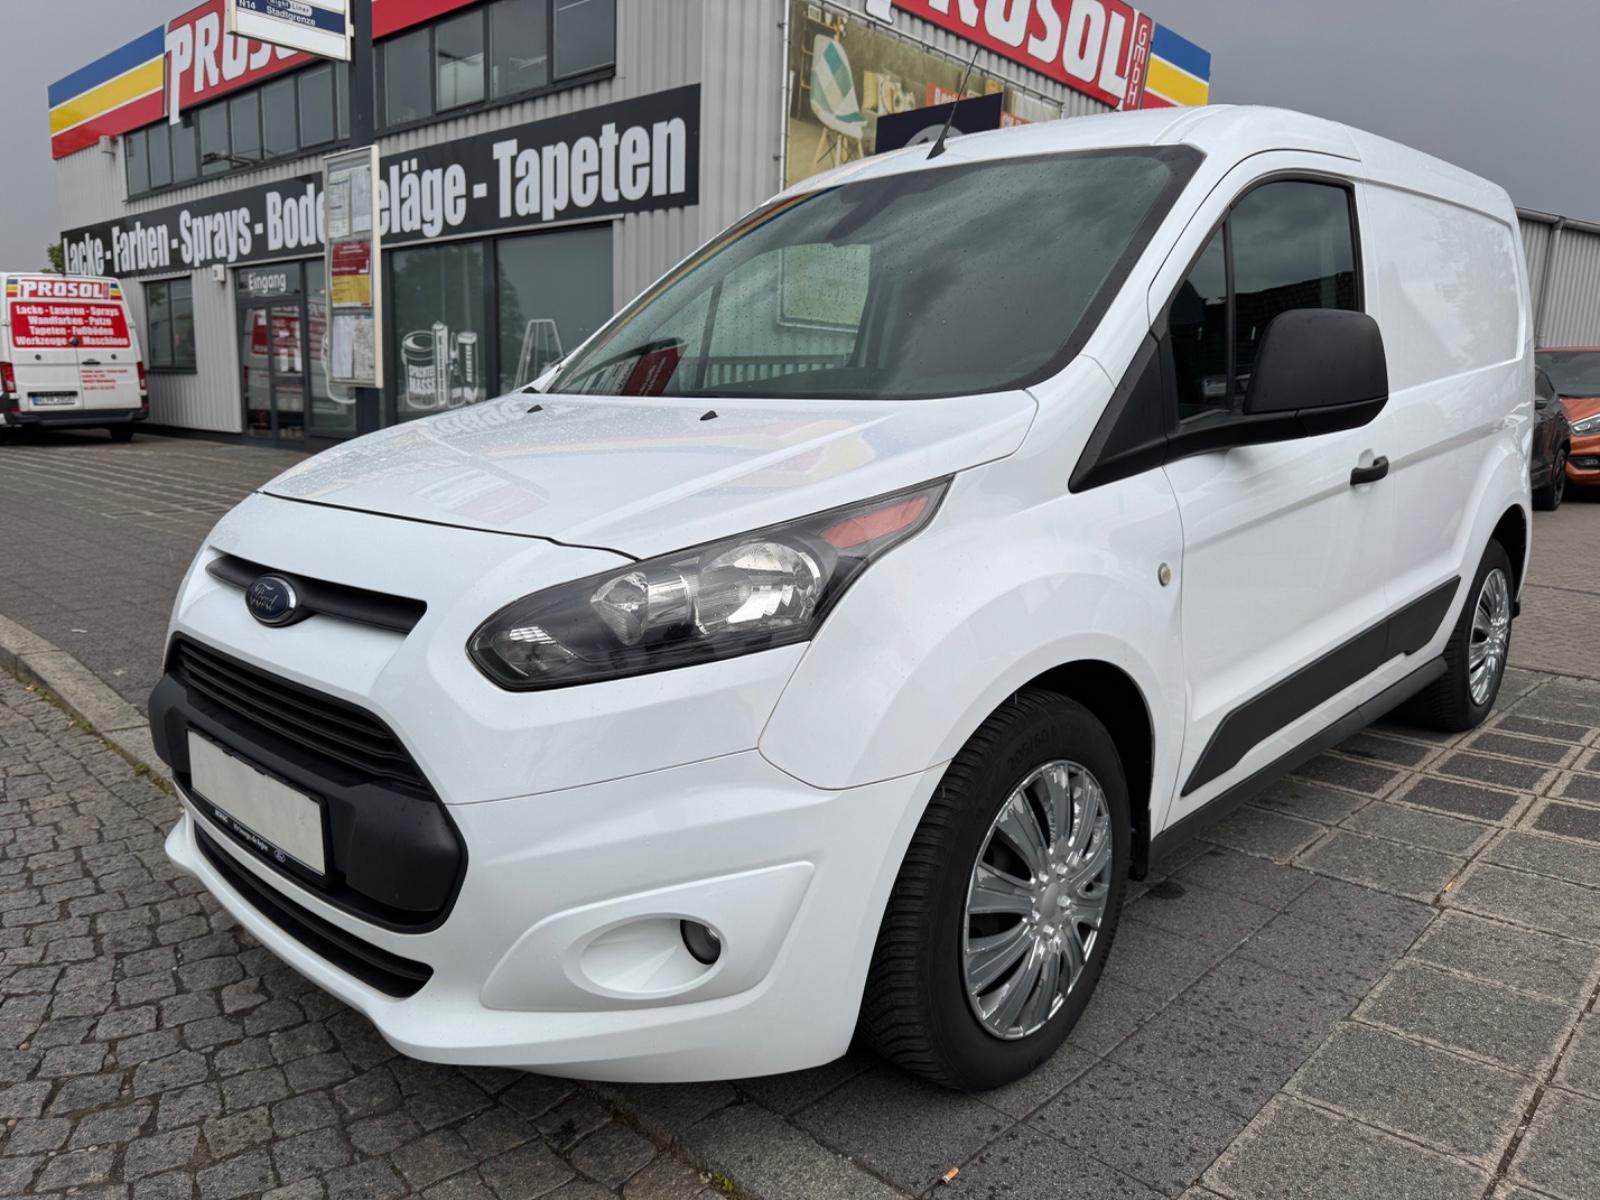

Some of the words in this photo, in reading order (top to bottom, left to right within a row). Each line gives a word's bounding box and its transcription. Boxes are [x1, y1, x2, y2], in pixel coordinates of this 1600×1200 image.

[266, 5, 316, 26] Stadtgrenze
[165, 11, 299, 126] PRO
[866, 0, 1128, 99] SOL
[63, 232, 105, 276] Lacke
[111, 221, 170, 273] Farben
[179, 207, 252, 267] Sprays
[493, 117, 686, 221] Tapeten
[21, 281, 103, 299] PROSOL
[248, 273, 286, 293] Eingang
